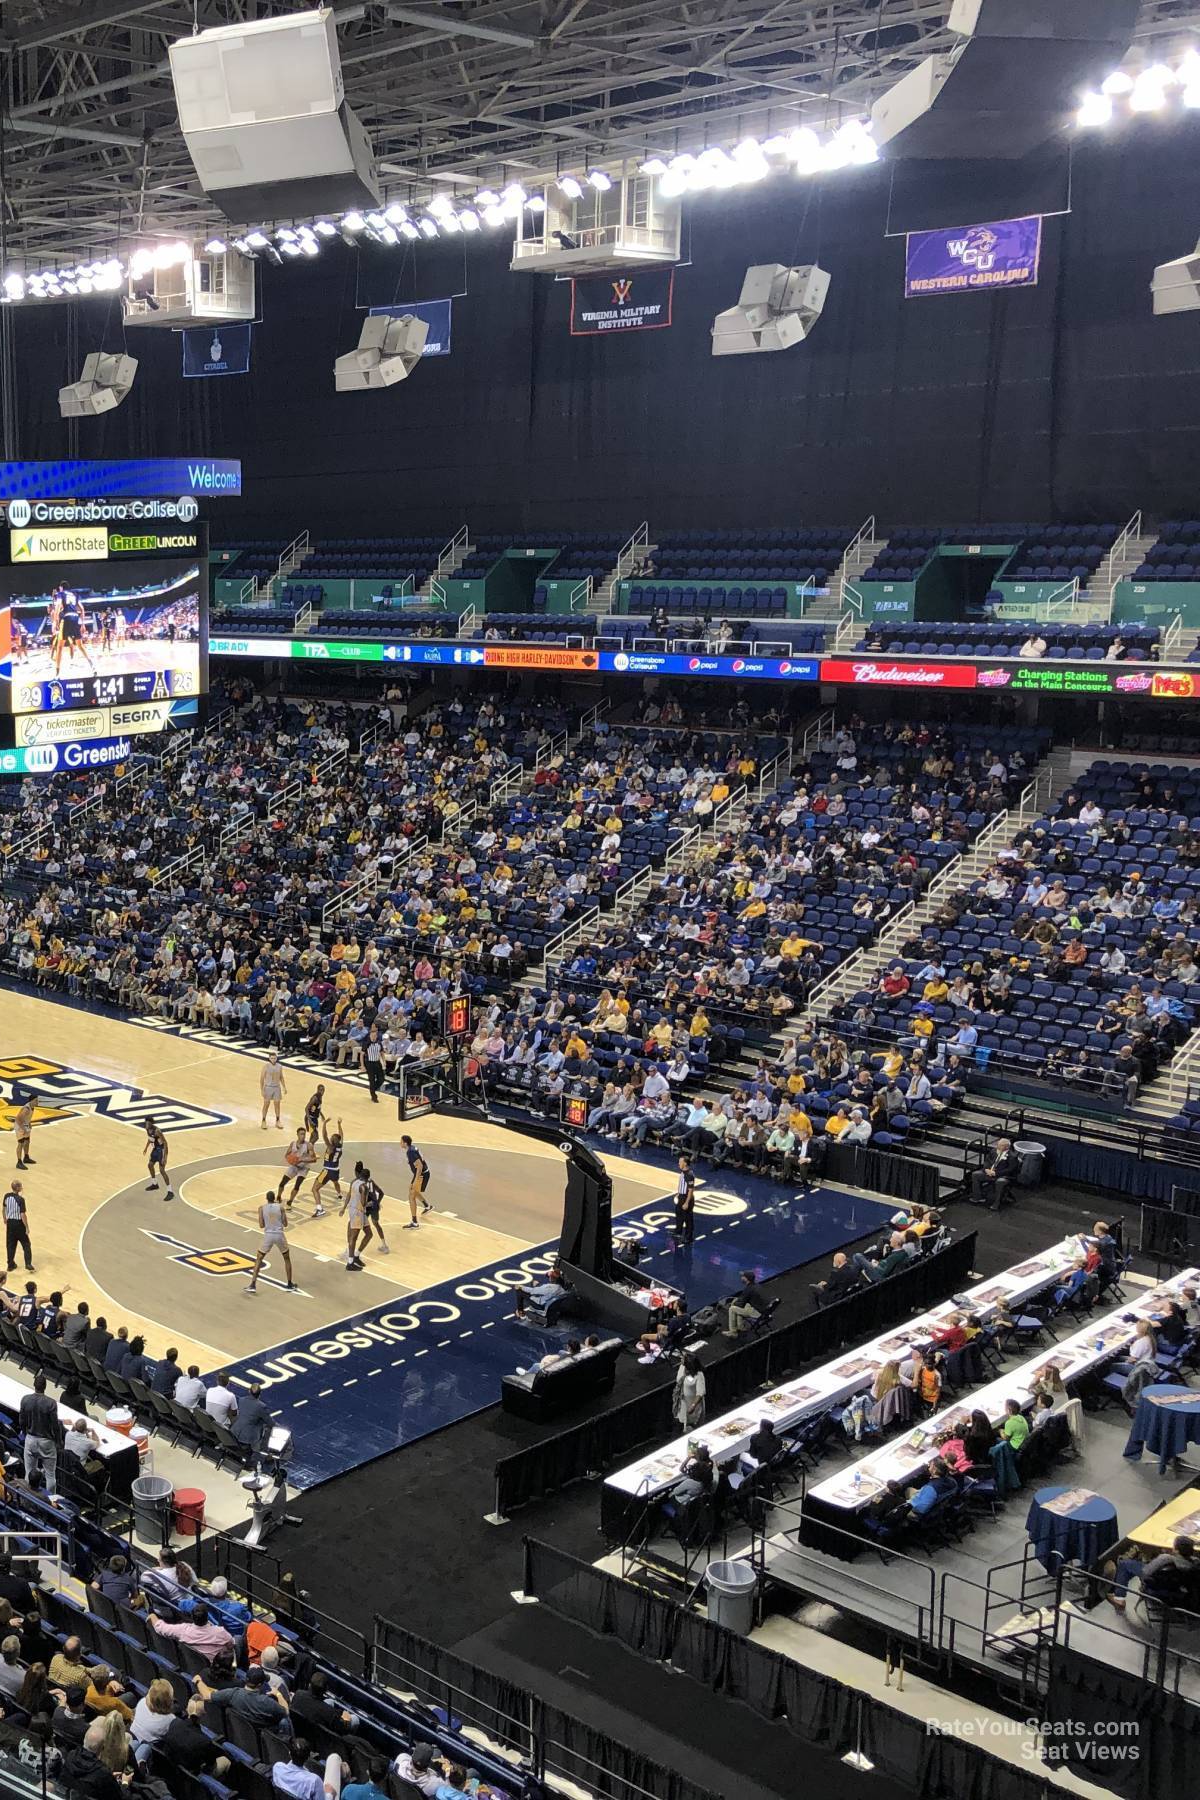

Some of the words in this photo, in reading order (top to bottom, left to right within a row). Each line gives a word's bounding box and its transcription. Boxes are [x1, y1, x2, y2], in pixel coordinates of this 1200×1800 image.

[910, 276, 967, 290] WESTERN
[969, 268, 1030, 283] CAROLINA
[582, 310, 618, 322] VIRGINIA
[620, 304, 661, 318] MILITARY
[598, 317, 643, 330] INSTITUTE
[188, 464, 236, 488] Welcome
[35, 502, 126, 522] Greensboro
[132, 500, 198, 518] Coliseum
[39, 534, 106, 552] NorthState
[218, 642, 249, 652] BRADY
[303, 644, 330, 658] TFA
[486, 652, 504, 662] RIDING
[506, 652, 520, 664] HIGH
[630, 656, 665, 664] Greensboro
[630, 662, 658, 670] Coliseum
[701, 662, 718, 670] pepsi
[852, 664, 944, 682] Budweiser
[174, 672, 192, 692] 26
[1018, 670, 1062, 682] Charging
[1064, 672, 1108, 682] Stations
[93, 678, 124, 697] 1:41
[1024, 680, 1039, 688] the
[1040, 681, 1062, 690] Main
[1065, 682, 1112, 692] Concourse
[21, 687, 42, 708] 29
[46, 716, 98, 730] ticketmaster
[112, 710, 161, 724] SEGRA
[73, 726, 97, 736] TICKETS
[452, 1010, 464, 1030] 18
[570, 1110, 582, 1122] 18
[20, 1304, 32, 1317] 13
[228, 1300, 461, 1390] Coliseum
